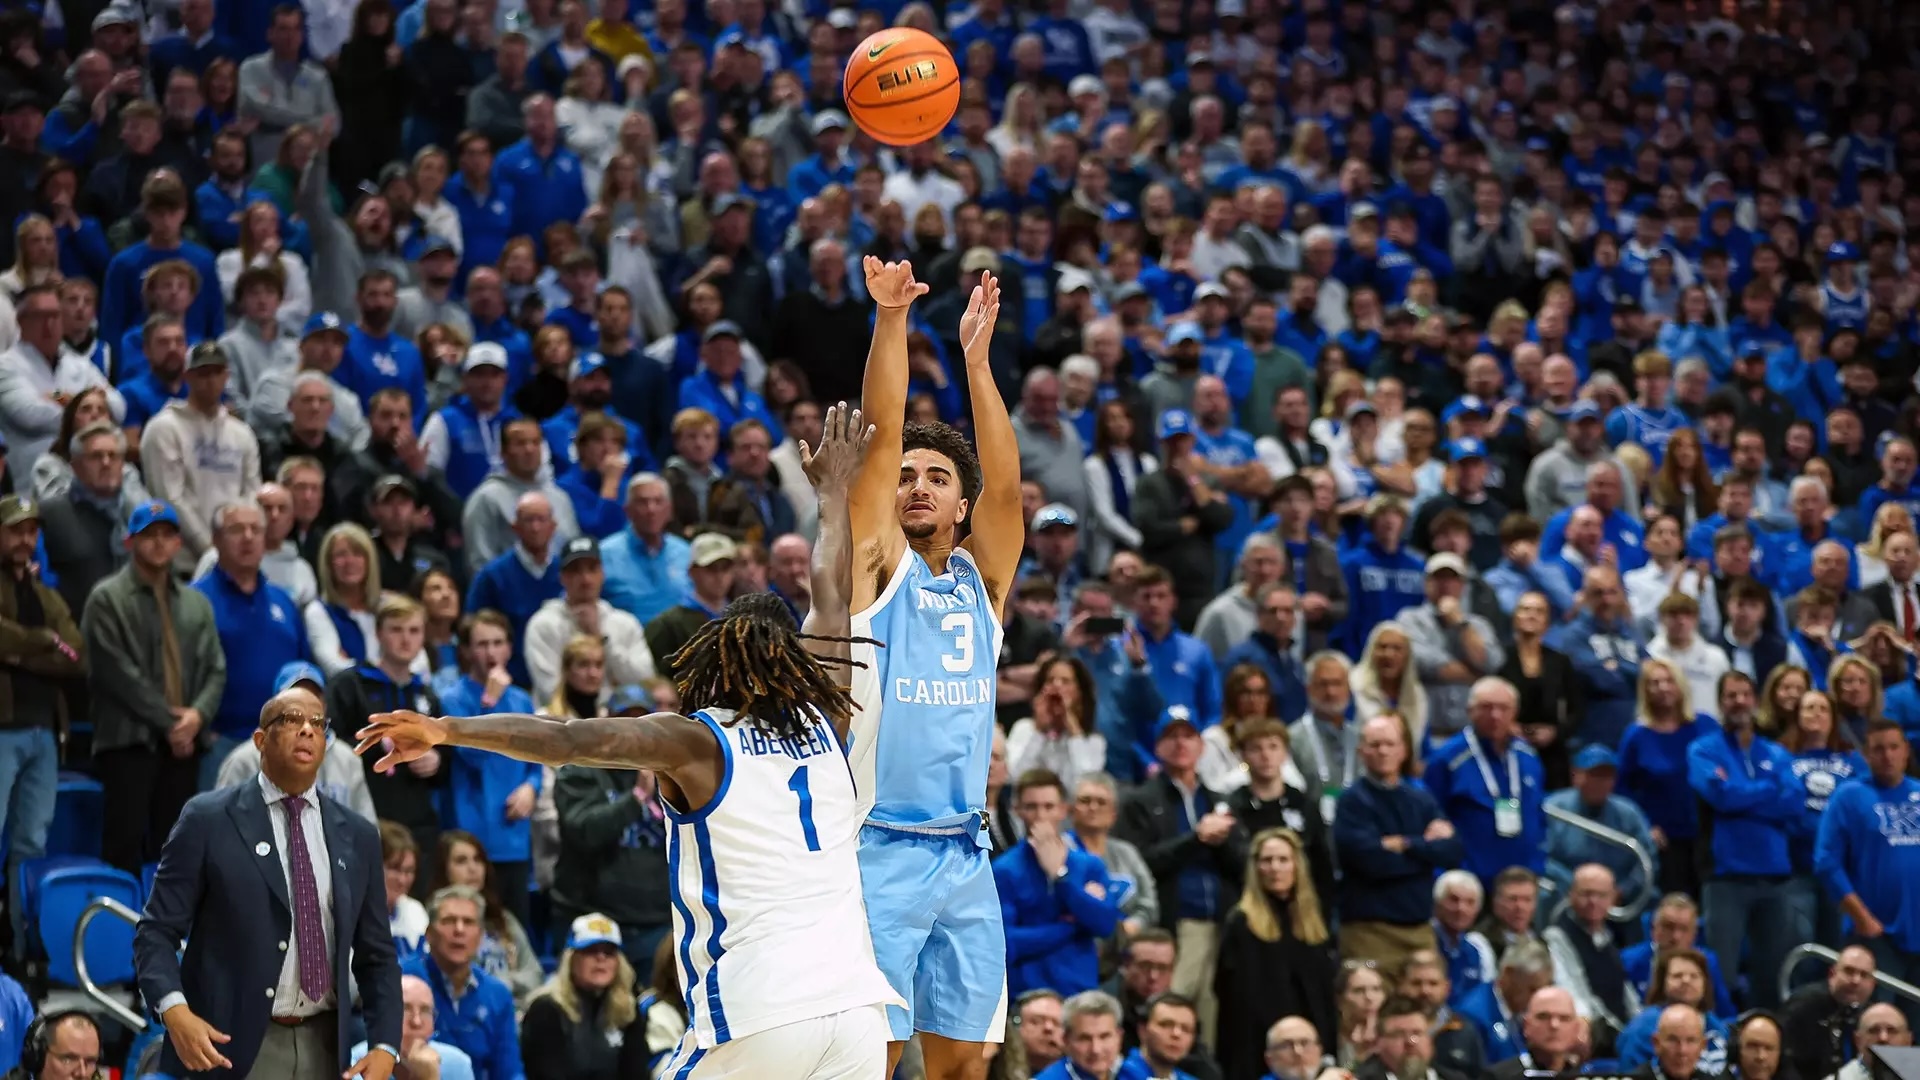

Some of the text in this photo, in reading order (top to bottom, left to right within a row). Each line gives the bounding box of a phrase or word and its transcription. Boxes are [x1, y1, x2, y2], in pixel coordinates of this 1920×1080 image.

[876, 60, 938, 92] ELITE
[941, 612, 974, 672] 3
[738, 726, 832, 760] ABEEEN
[788, 765, 821, 852] 1
